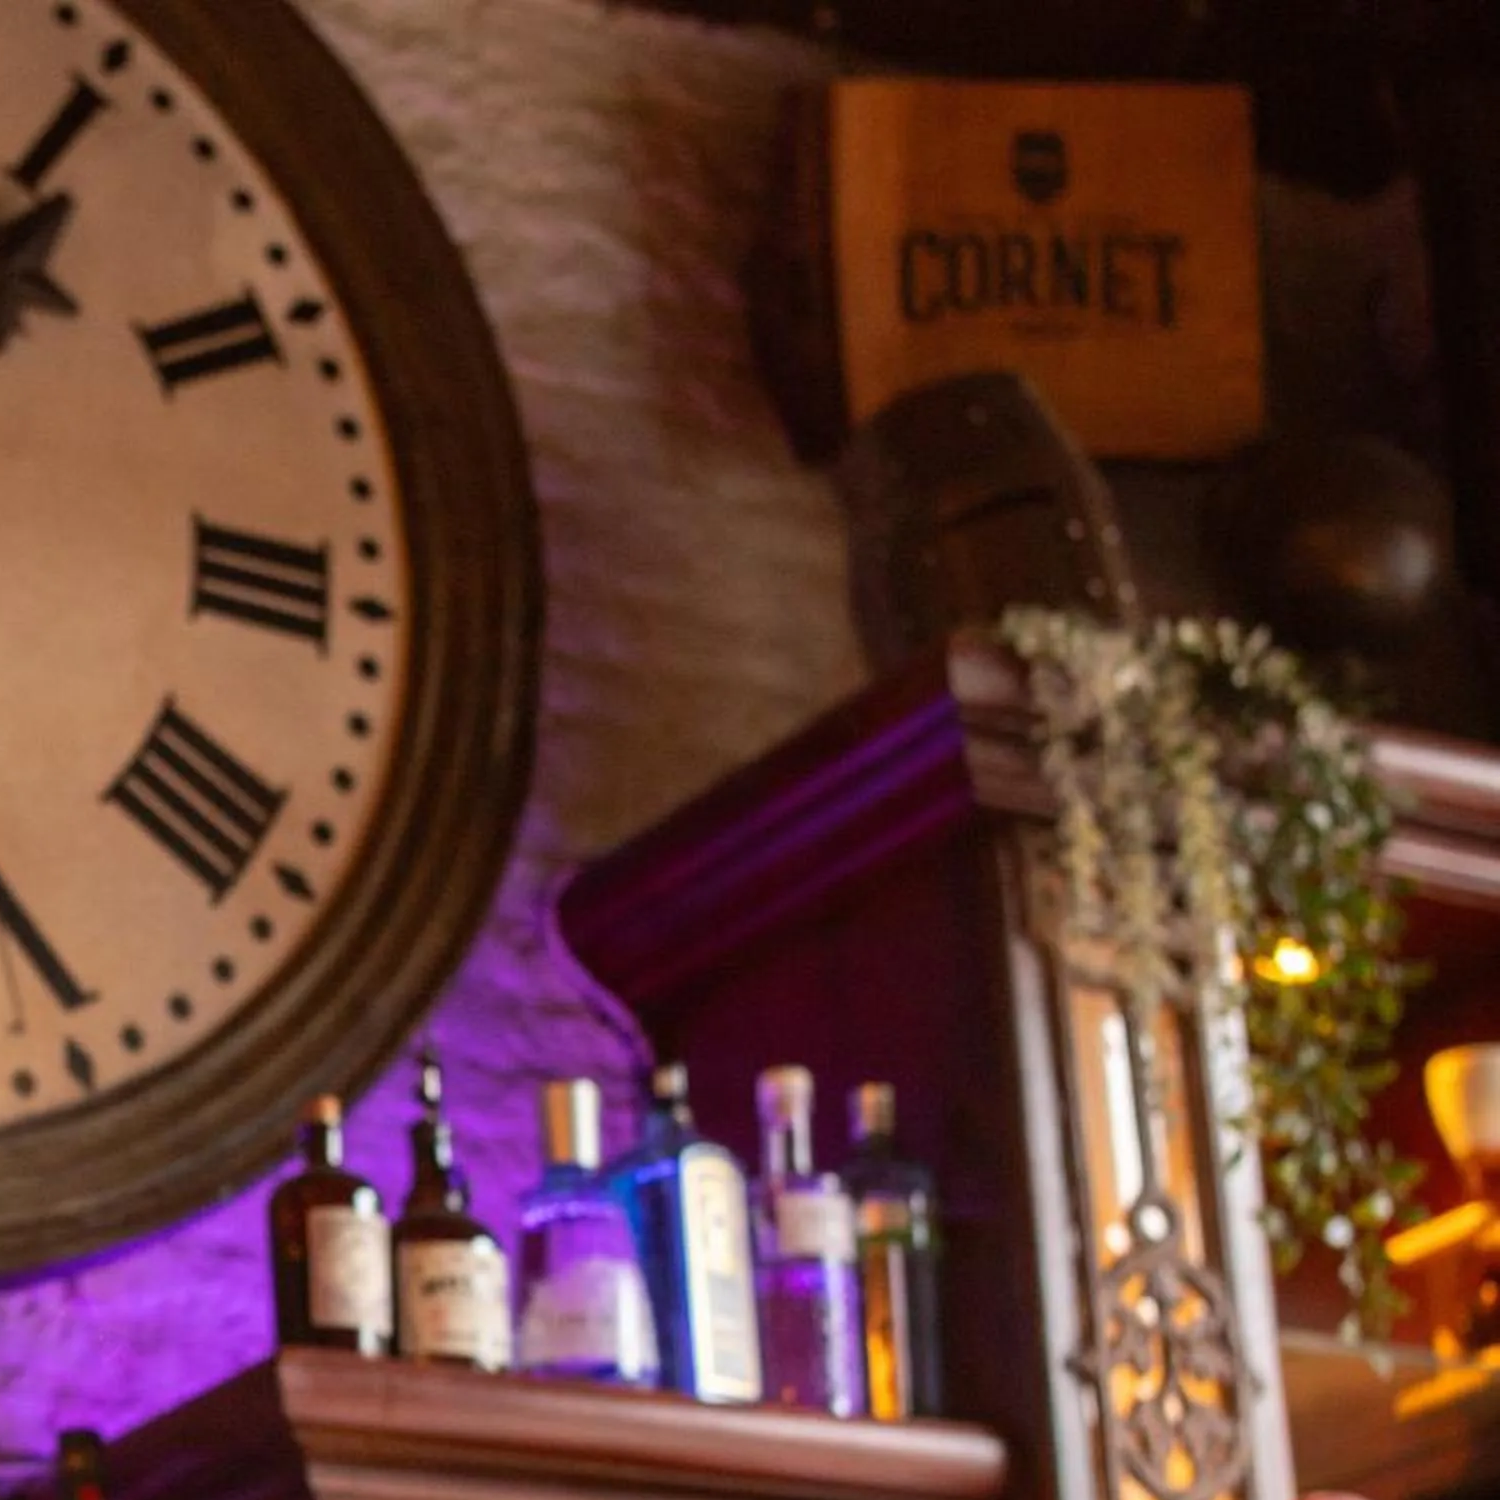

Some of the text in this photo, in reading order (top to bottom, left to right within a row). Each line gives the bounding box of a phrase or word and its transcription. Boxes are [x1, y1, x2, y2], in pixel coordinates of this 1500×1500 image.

[900, 226, 1184, 332] CORNET
[128, 284, 288, 404] II
[187, 506, 331, 662] III
